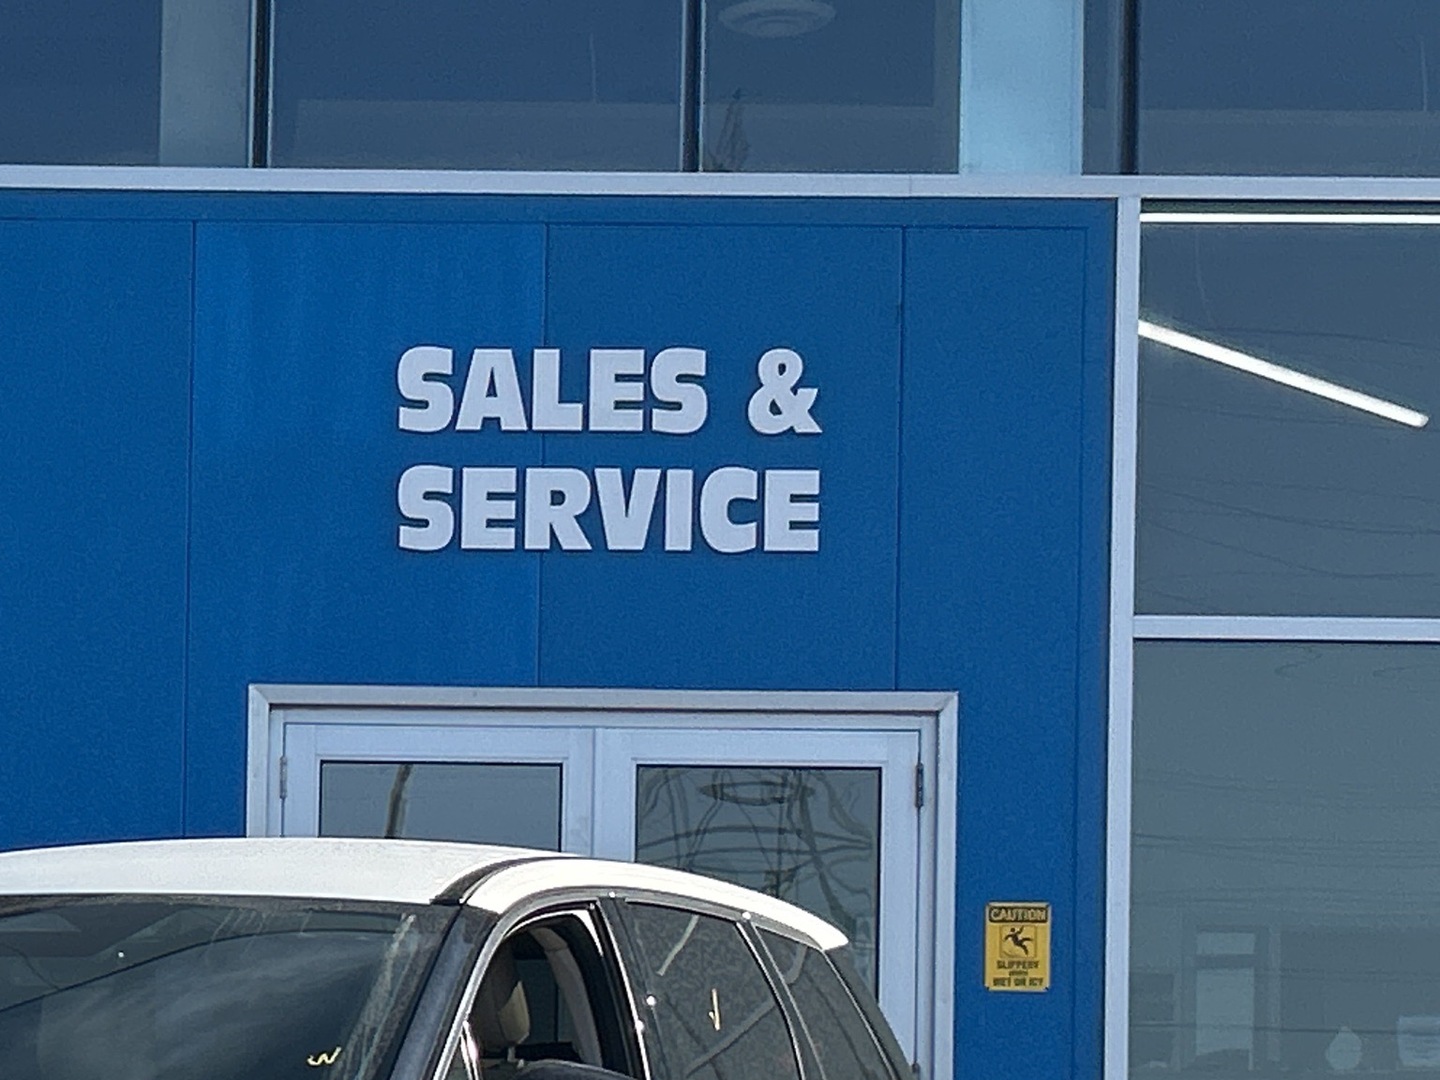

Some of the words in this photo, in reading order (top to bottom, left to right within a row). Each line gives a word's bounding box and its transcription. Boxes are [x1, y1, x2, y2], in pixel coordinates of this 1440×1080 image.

[397, 346, 708, 433] SALES
[747, 348, 823, 435] &
[397, 465, 820, 553] SERVICE
[990, 908, 1046, 921] CAUTION
